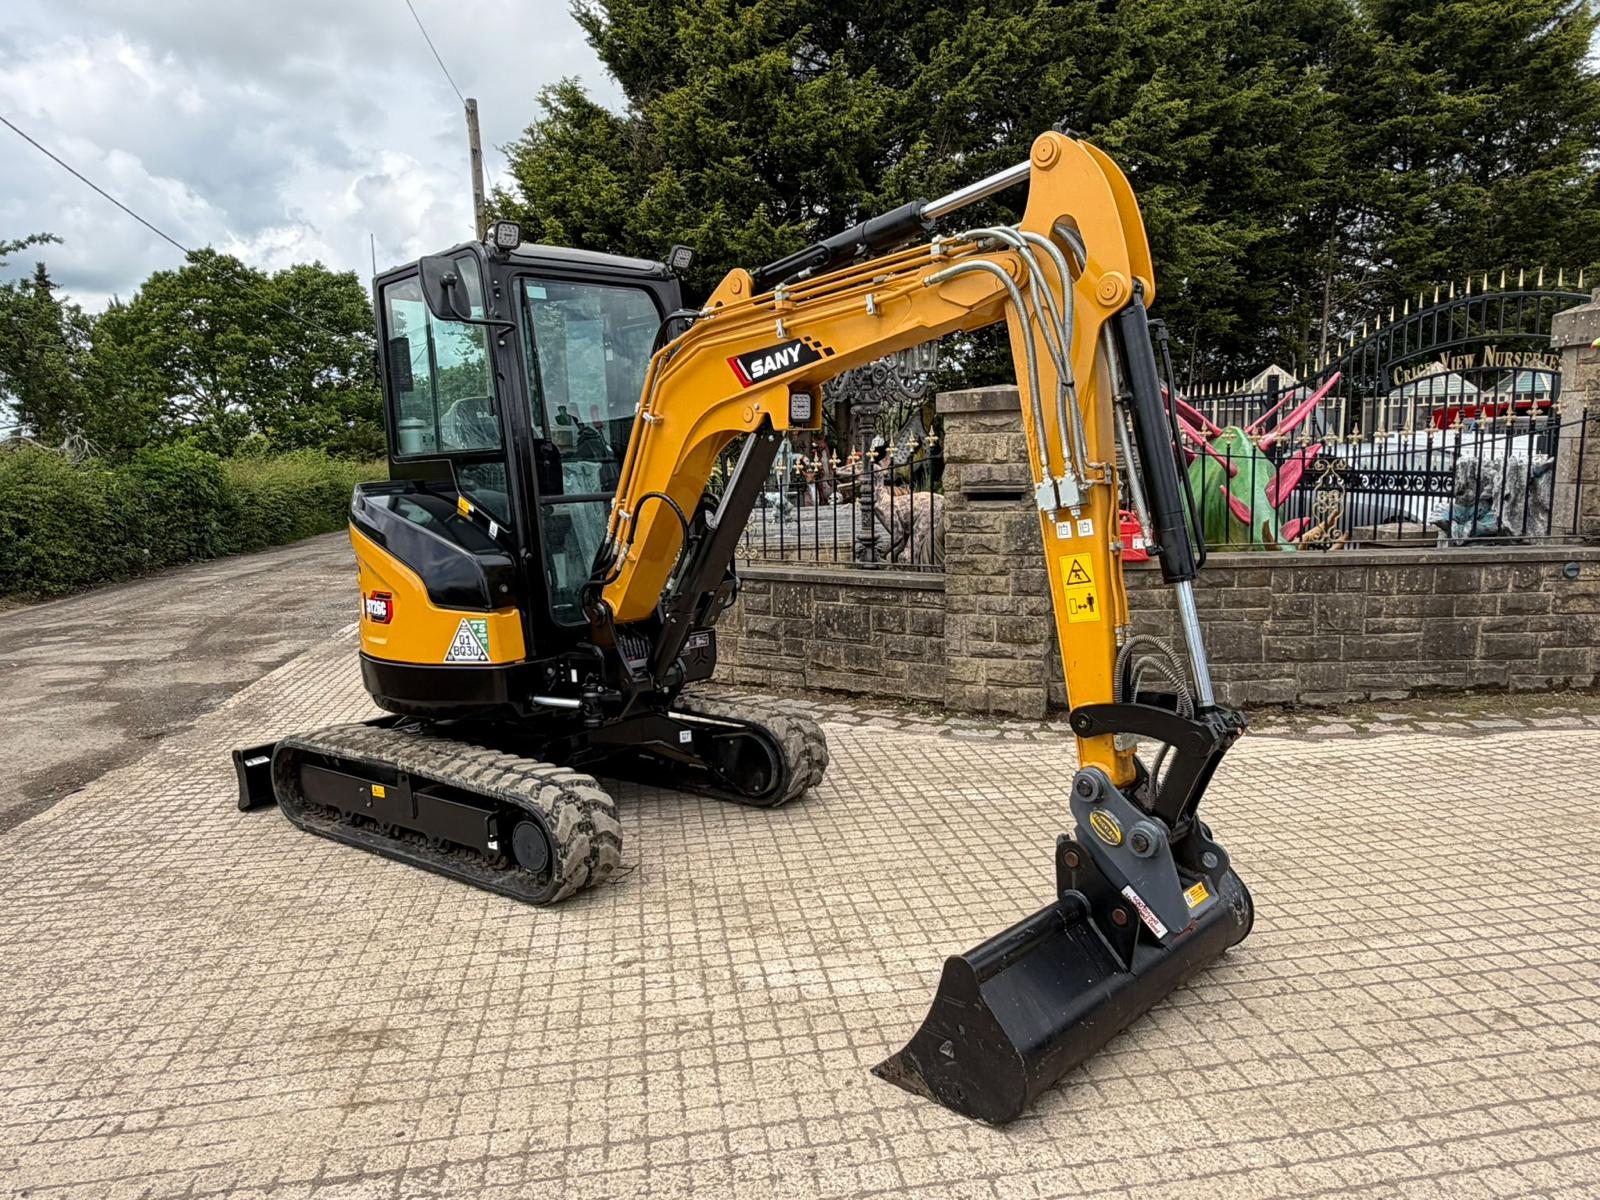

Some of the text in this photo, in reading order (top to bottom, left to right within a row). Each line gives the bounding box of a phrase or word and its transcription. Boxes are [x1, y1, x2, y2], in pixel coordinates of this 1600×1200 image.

[750, 343, 801, 379] SANY
[1439, 350, 1476, 371] VIEW
[1481, 344, 1563, 372] NURSERIE
